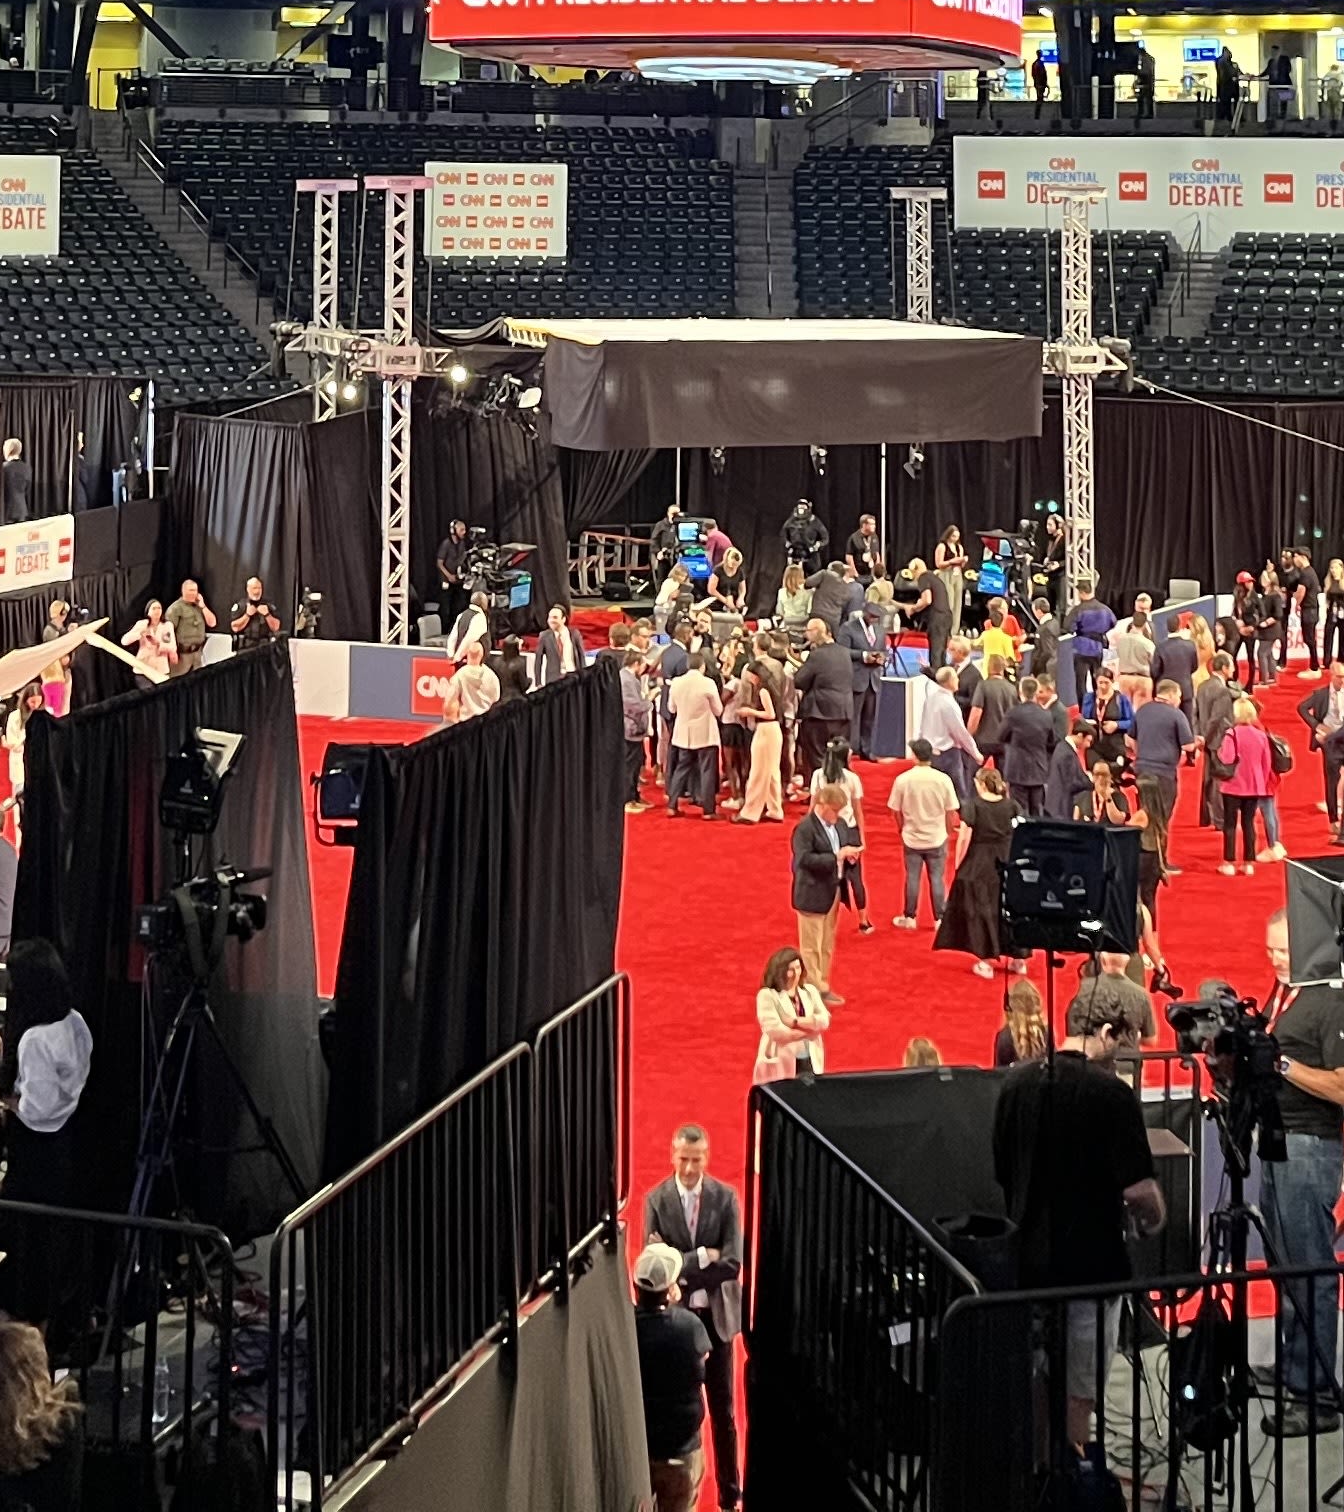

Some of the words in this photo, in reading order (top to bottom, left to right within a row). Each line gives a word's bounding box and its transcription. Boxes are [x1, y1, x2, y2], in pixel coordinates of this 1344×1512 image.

[1027, 171, 1099, 184] PRESIDENTIAL
[1168, 172, 1243, 185] PRESIDENTIAL
[1169, 185, 1243, 207] DEBATE
[15, 553, 50, 576] DEBATE
